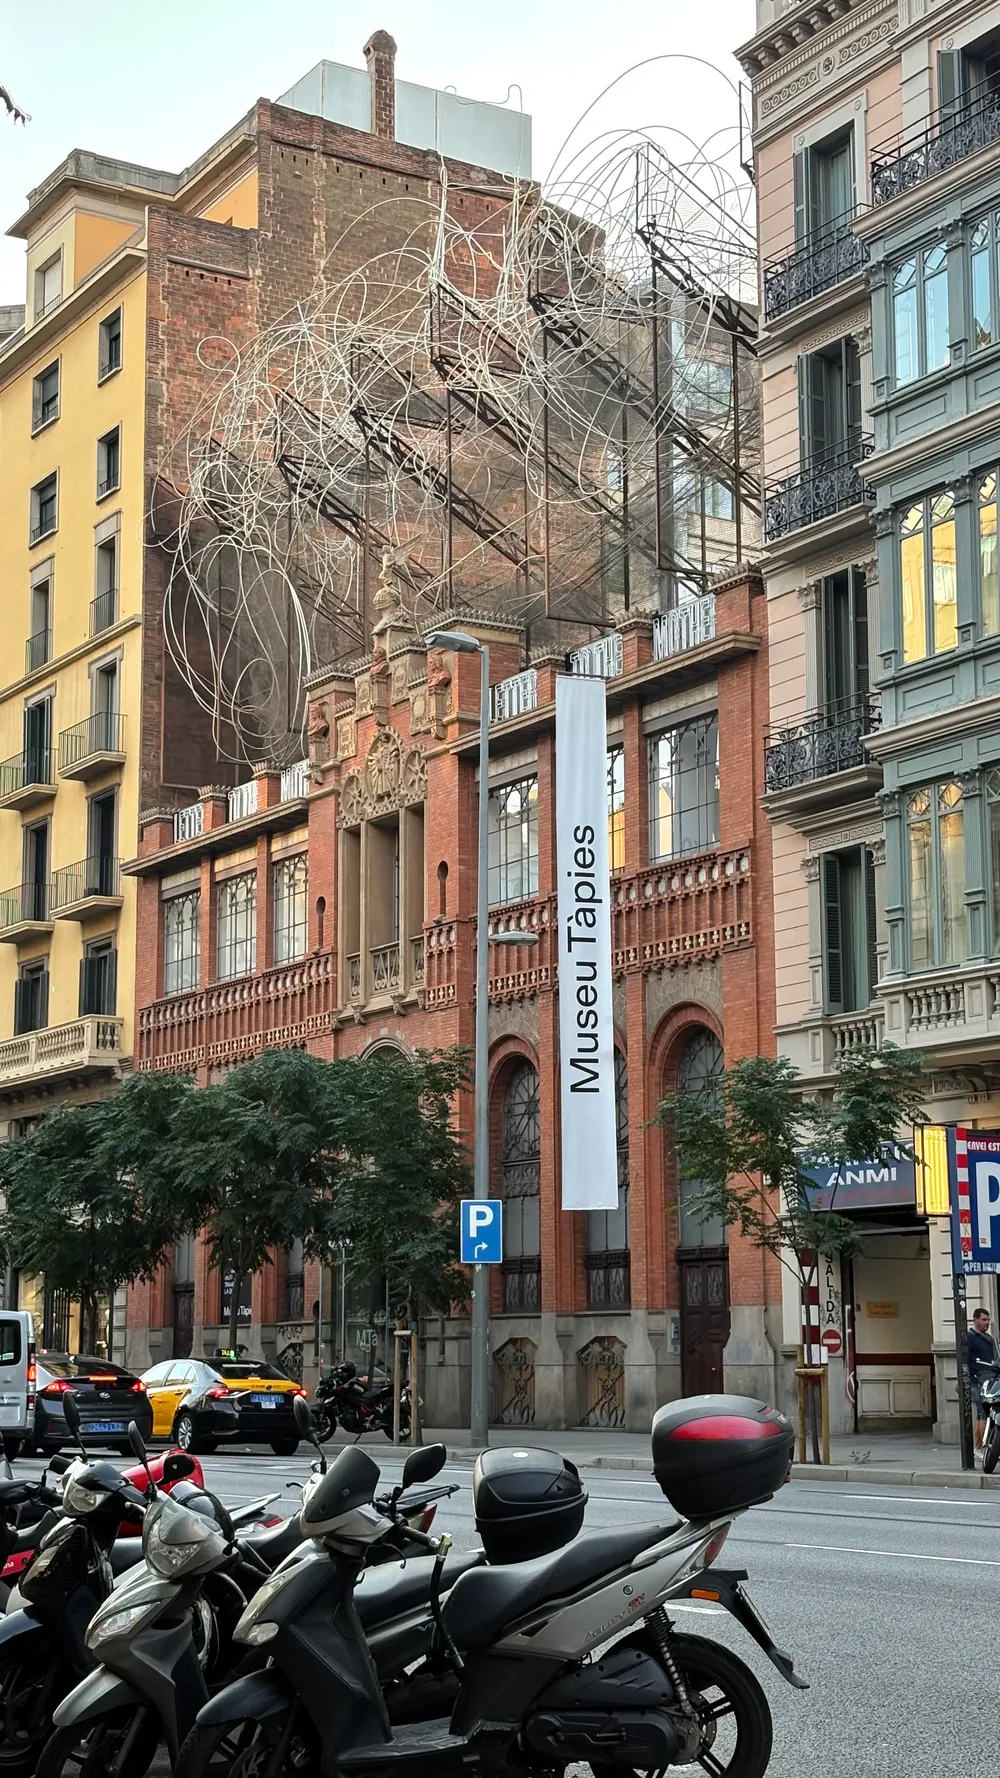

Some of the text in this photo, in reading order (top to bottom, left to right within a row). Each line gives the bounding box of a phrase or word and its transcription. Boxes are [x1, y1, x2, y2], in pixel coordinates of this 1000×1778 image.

[653, 596, 717, 660] MOTHE
[567, 825, 602, 1094] Museu Tàpies
[967, 1141, 1000, 1151] ERVEI EST
[826, 1167, 898, 1187] ANMI
[469, 1205, 494, 1238] P
[975, 1161, 1000, 1248] P
[825, 1252, 835, 1325] SALIDA
[969, 1262, 982, 1272] PER
